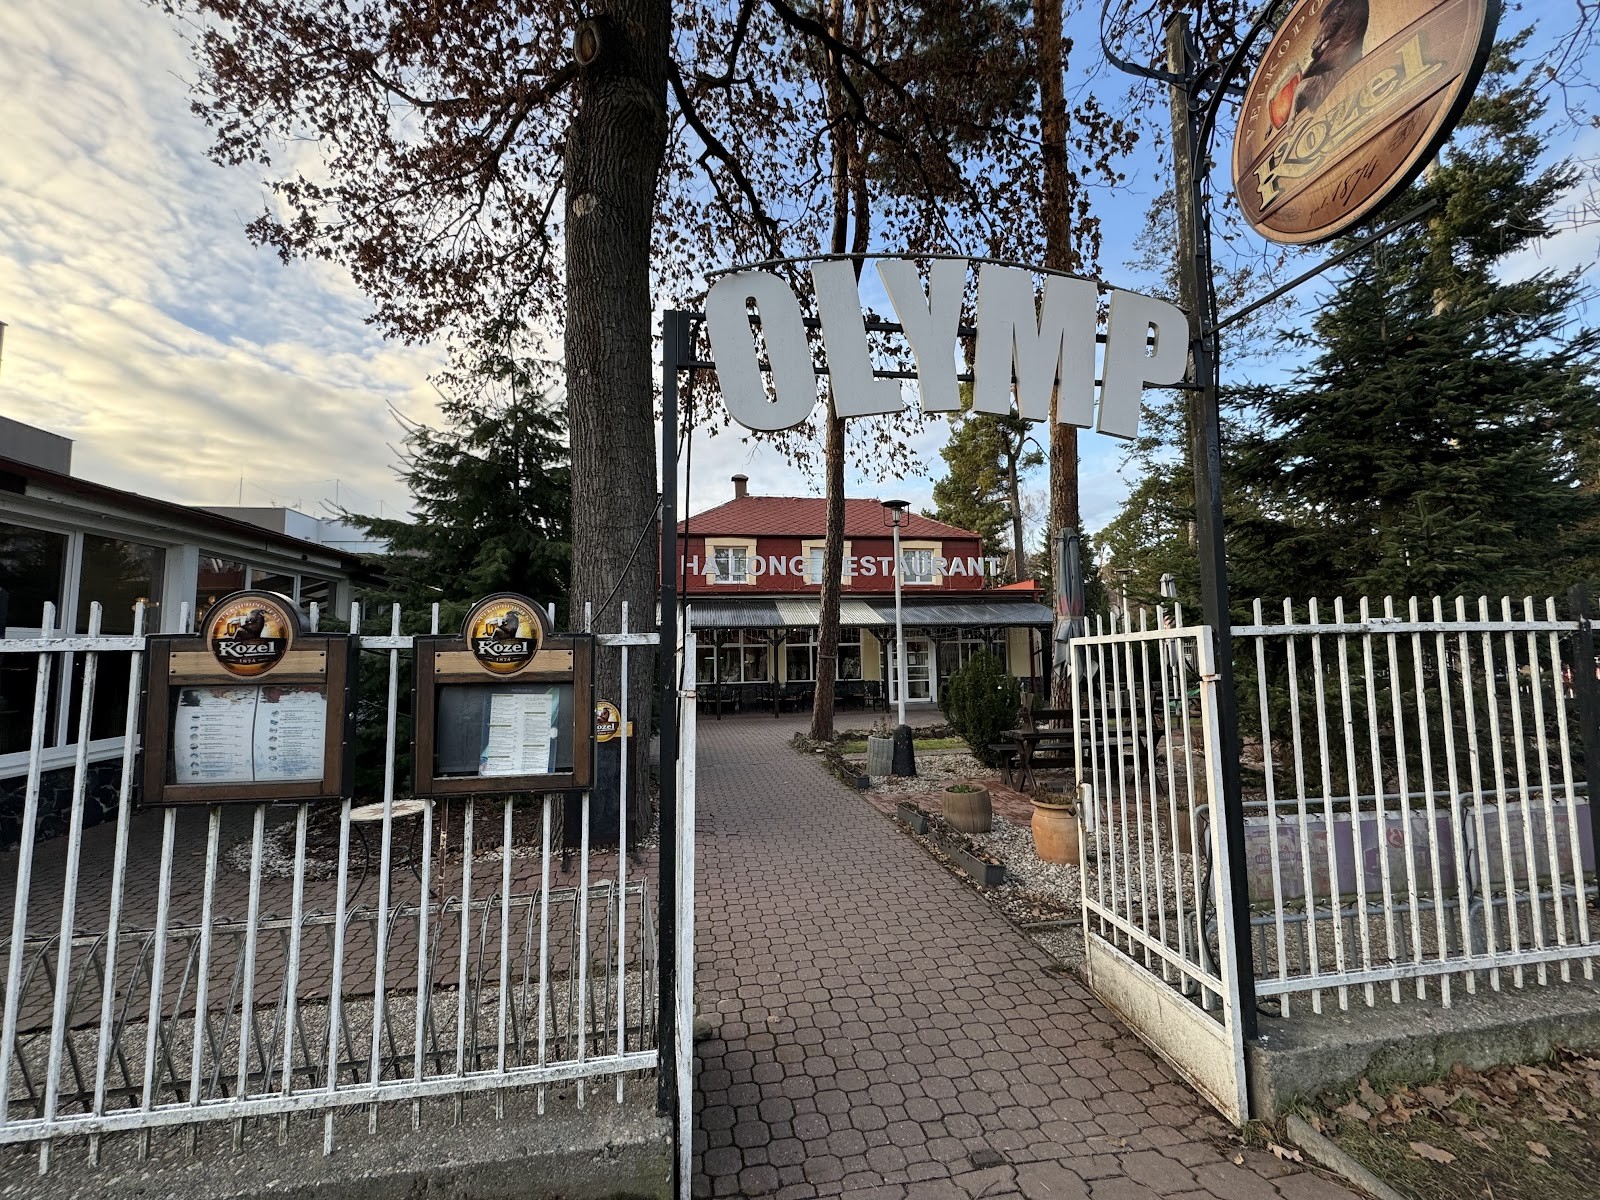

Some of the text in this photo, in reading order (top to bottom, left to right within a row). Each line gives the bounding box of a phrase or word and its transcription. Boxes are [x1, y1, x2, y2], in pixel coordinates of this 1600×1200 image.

[1253, 33, 1443, 211] Kozel
[1332, 155, 1381, 207] 1874
[705, 258, 1190, 440] OLYMP
[681, 555, 1000, 577] HA LONG ESTAURANT
[219, 641, 276, 658] Kozel
[478, 640, 528, 656] Kozel
